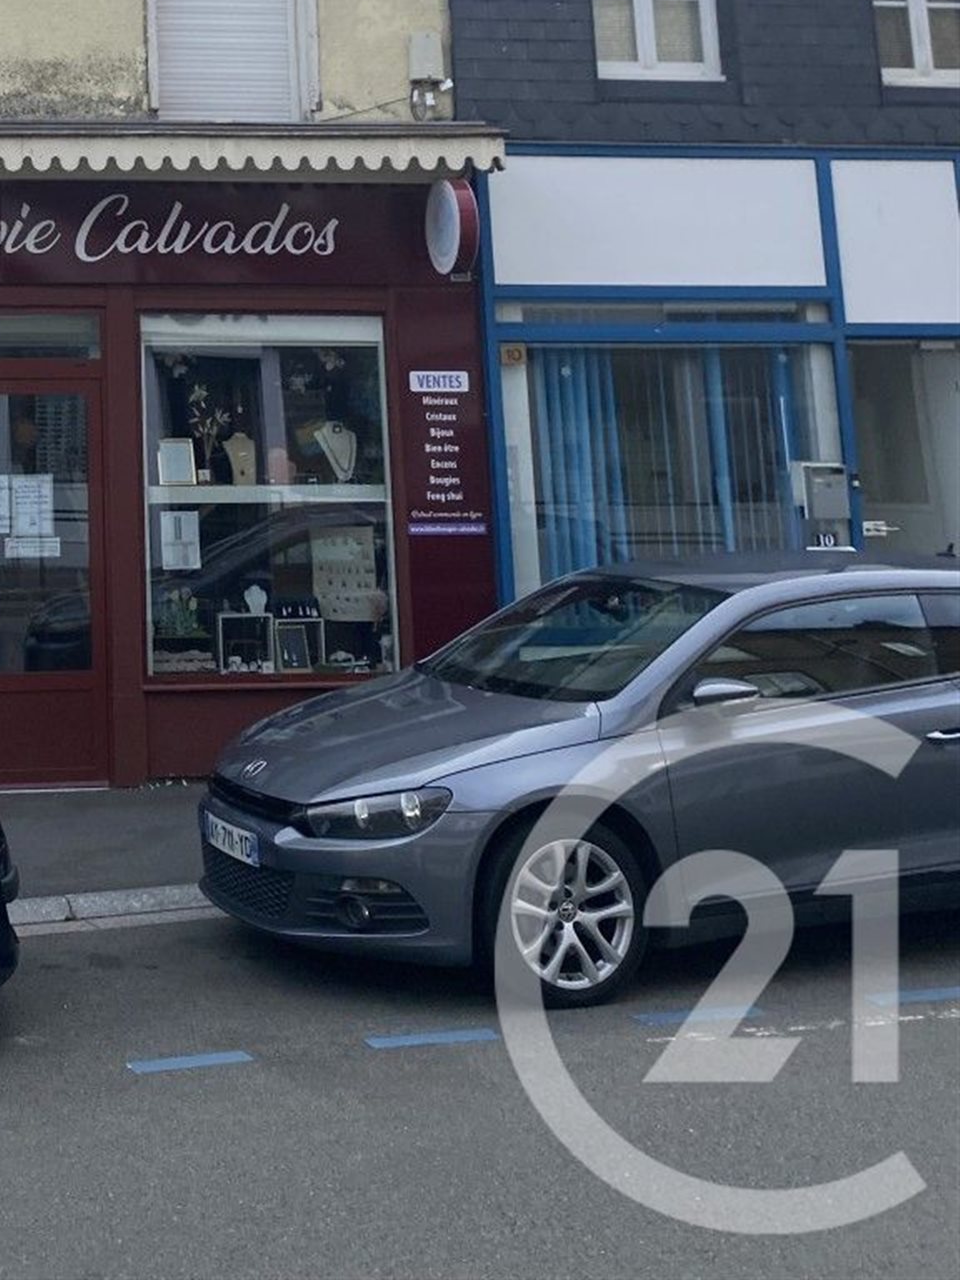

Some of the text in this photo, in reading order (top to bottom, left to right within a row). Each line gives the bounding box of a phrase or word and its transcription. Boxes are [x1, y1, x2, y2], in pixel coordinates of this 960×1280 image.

[74, 193, 341, 263] Calvados
[416, 374, 462, 389] VENTES
[425, 411, 457, 421] Cristaux
[430, 427, 455, 439] Bijoux
[424, 442, 442, 453] Bien
[430, 459, 458, 469] Encens
[429, 474, 461, 487] Bougies
[426, 490, 445, 502] Feng
[819, 533, 835, 548] 10
